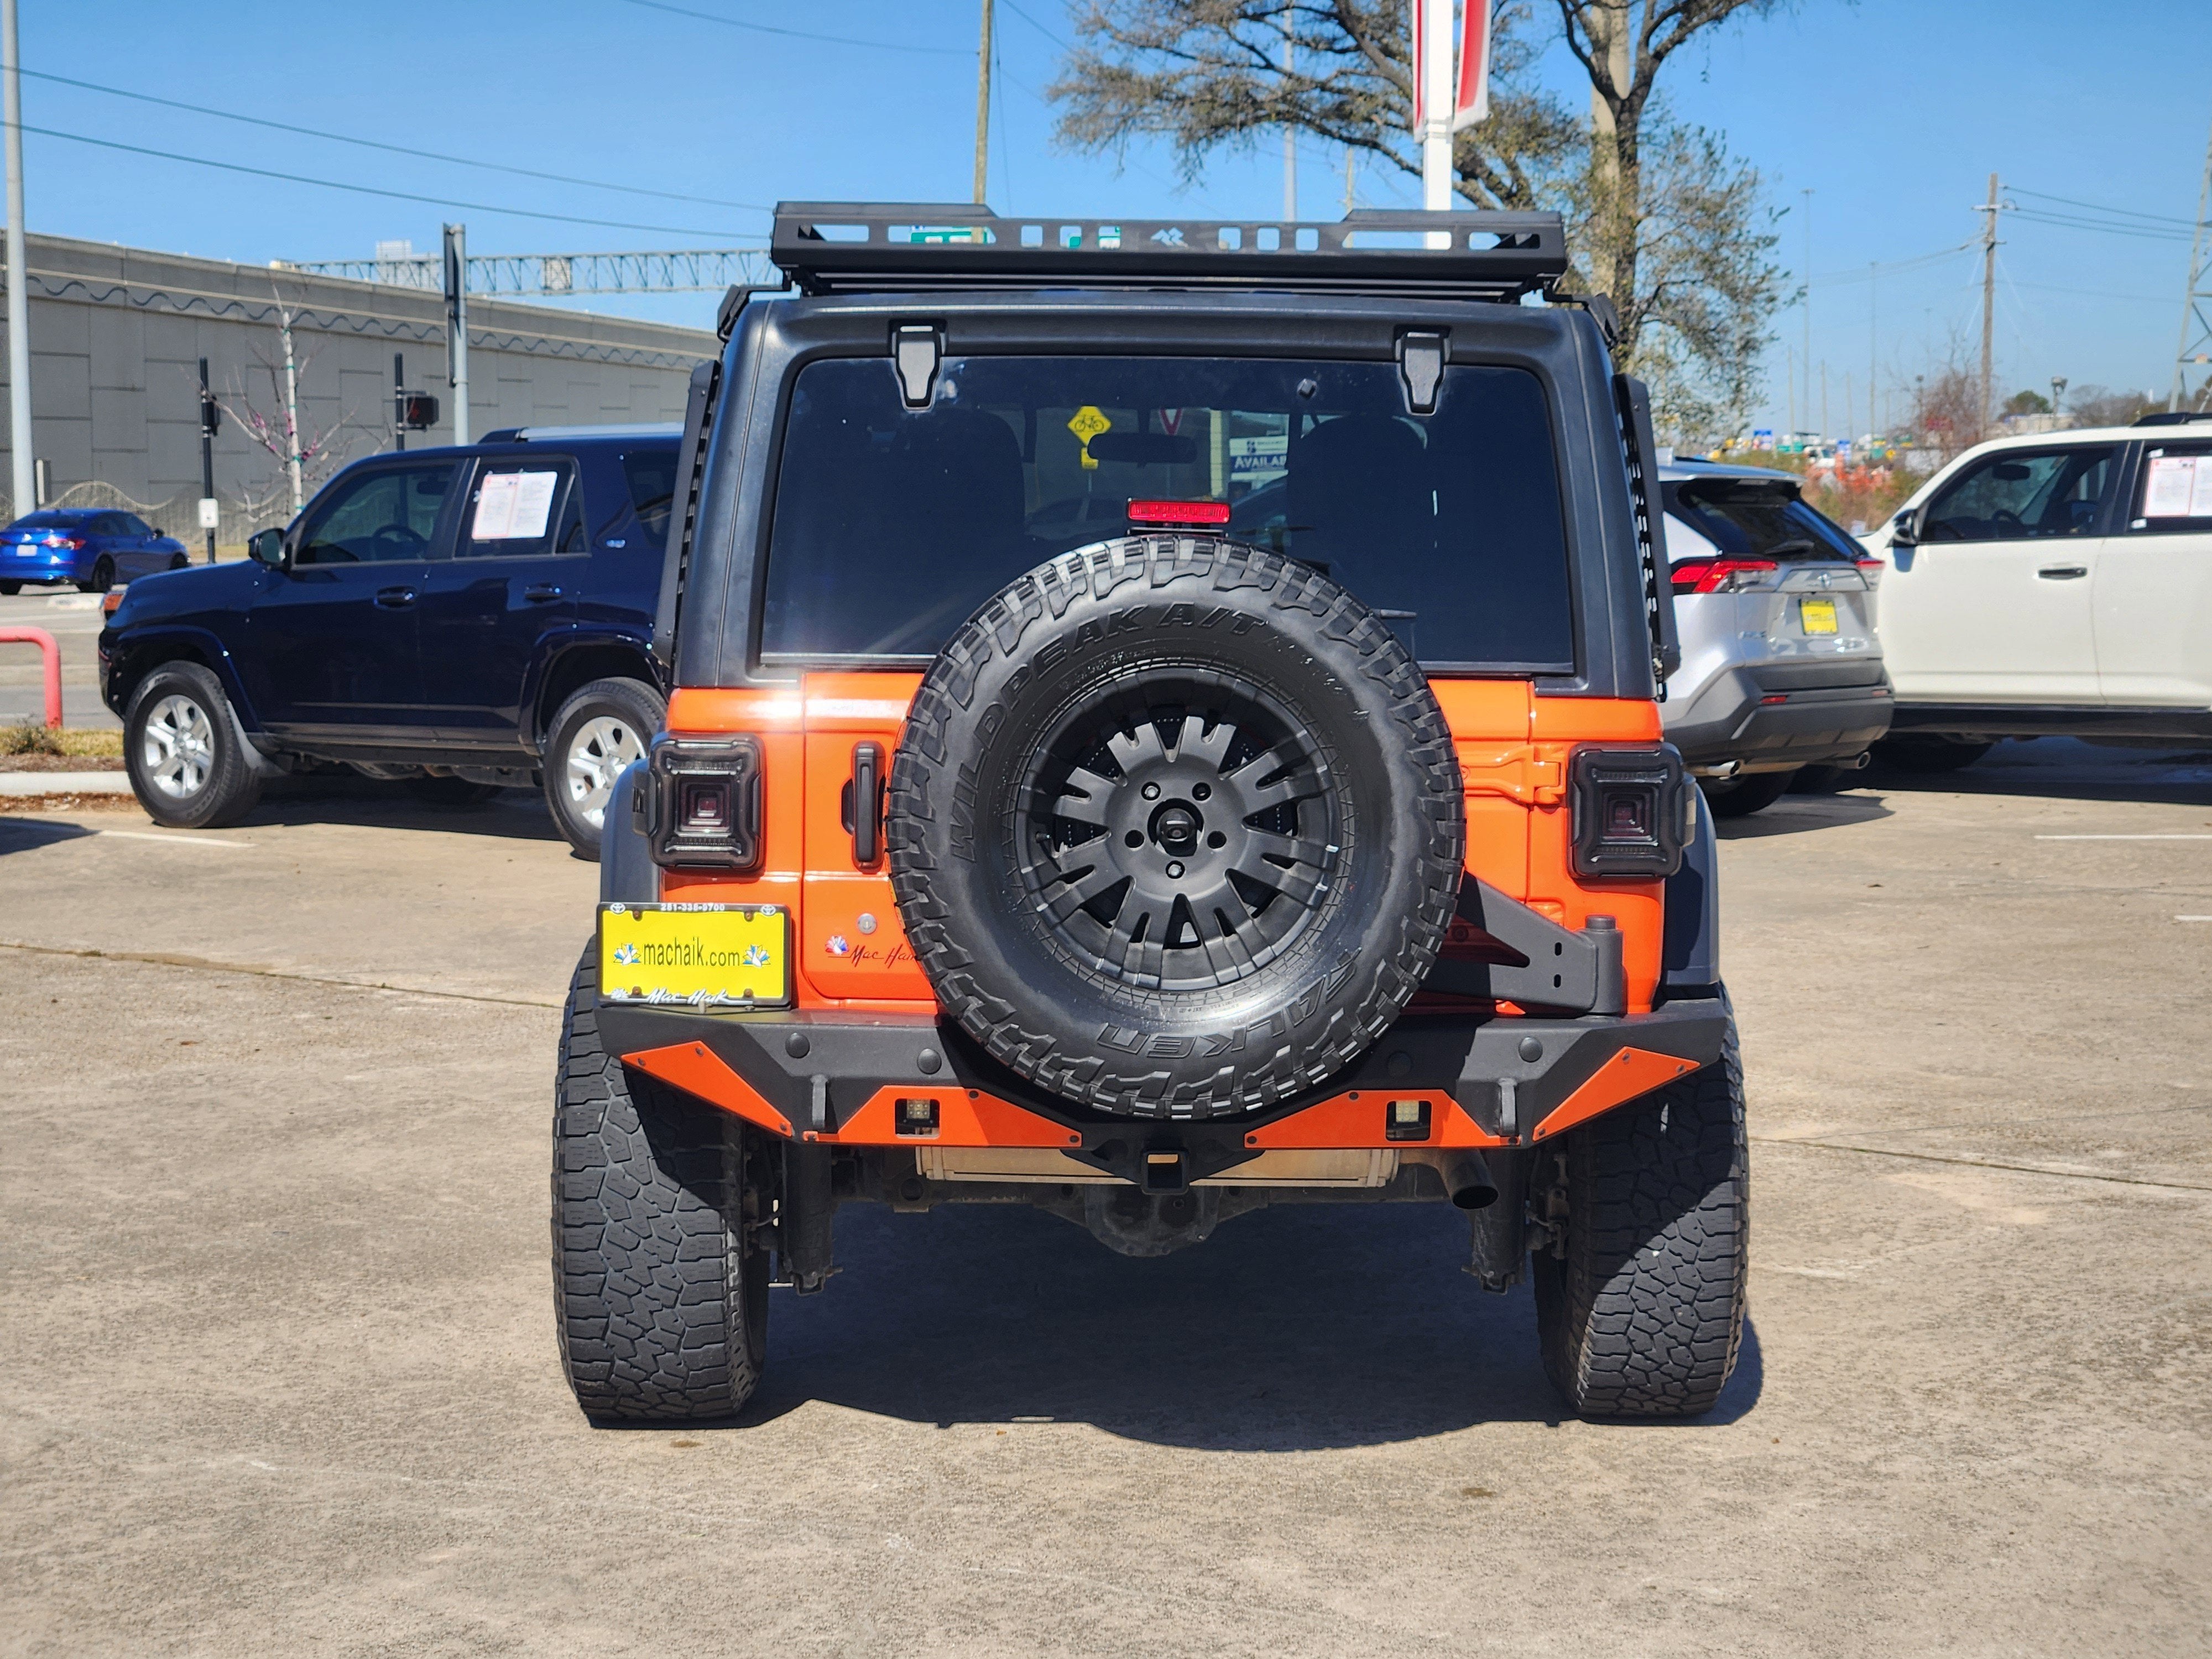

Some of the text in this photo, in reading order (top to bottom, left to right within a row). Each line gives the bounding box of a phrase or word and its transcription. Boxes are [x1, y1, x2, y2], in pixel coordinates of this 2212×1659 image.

[950, 604, 1149, 863] WILDPEAK
[644, 936, 740, 967] machaik.com
[850, 944, 884, 968] Mac
[646, 987, 729, 1005] Mac Haik
[1096, 946, 1362, 1058] FALKEN
